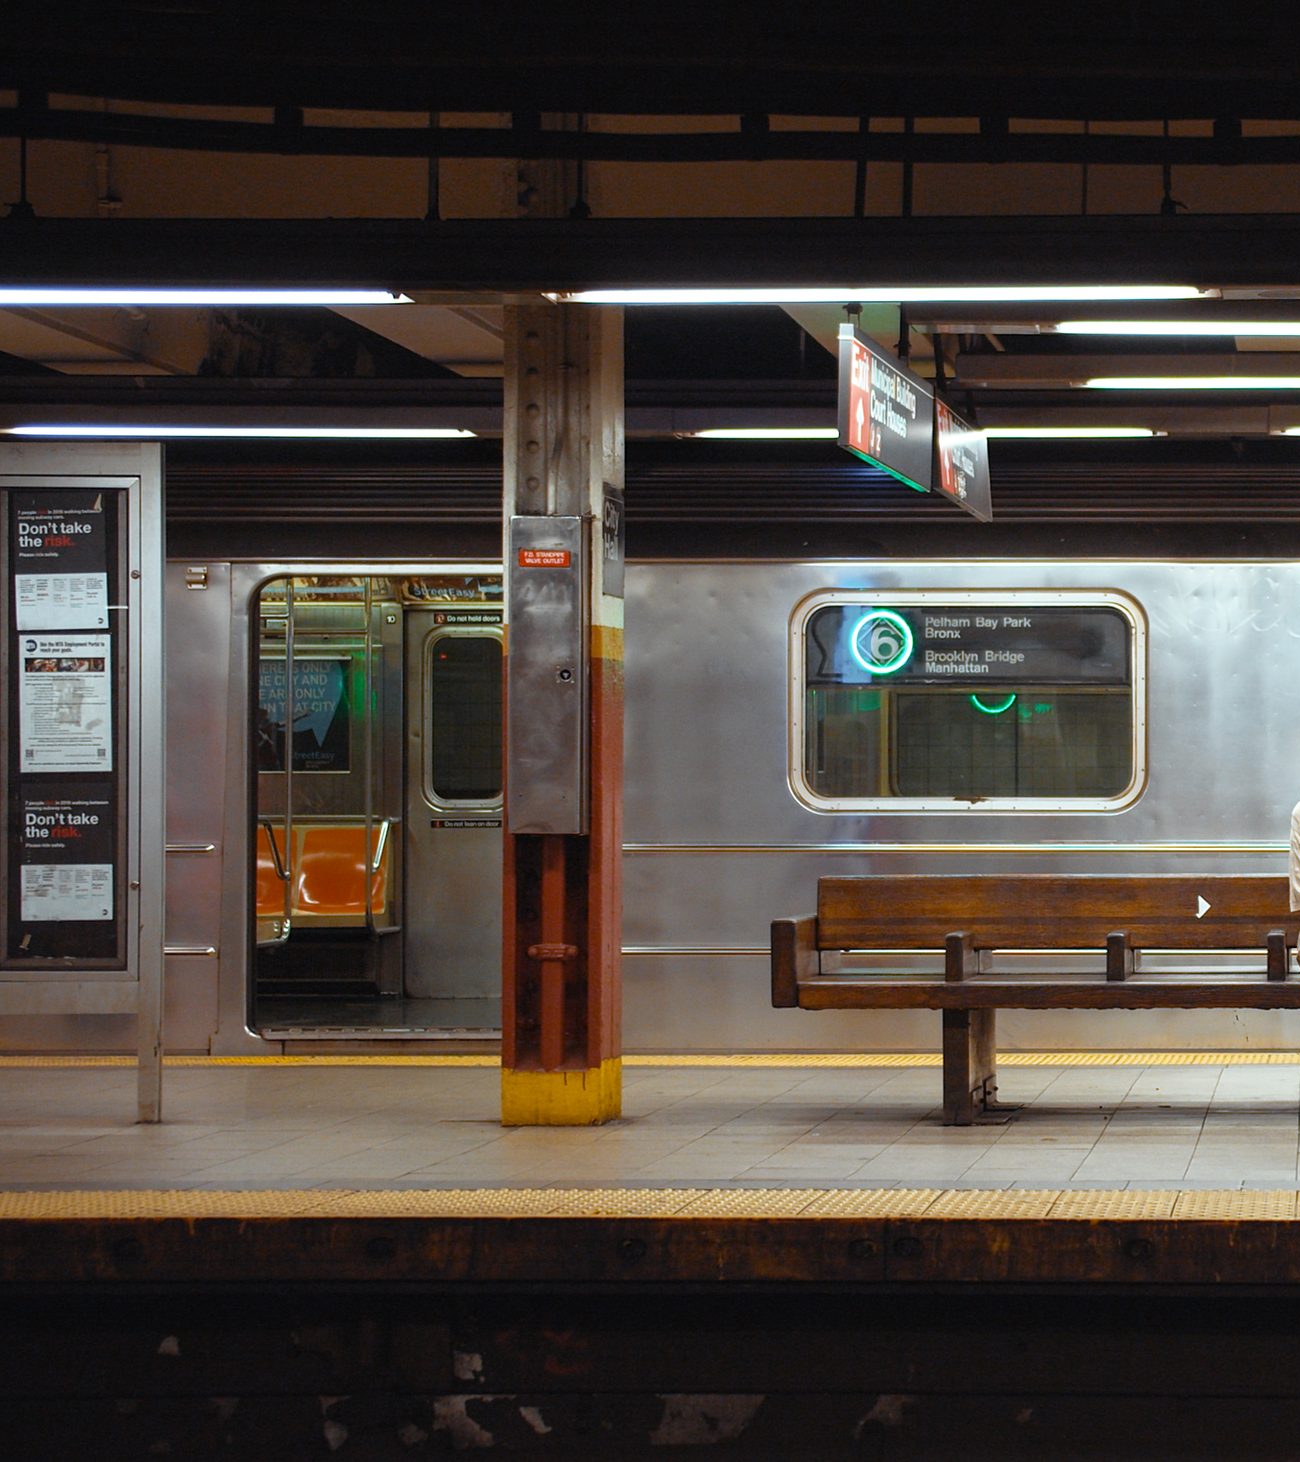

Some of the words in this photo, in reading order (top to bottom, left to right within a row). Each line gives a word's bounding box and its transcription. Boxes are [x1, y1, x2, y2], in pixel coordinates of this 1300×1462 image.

[851, 343, 870, 393] Exit
[871, 356, 897, 402] Municipal
[897, 375, 917, 420] Building
[870, 389, 887, 425] Court
[886, 400, 907, 438] Houses
[605, 501, 620, 536] City
[18, 522, 58, 535] Don't
[60, 521, 92, 535] take
[18, 535, 43, 548] the
[44, 535, 76, 547] risk.
[413, 585, 476, 599] StreetEasy
[386, 615, 396, 623] 10
[925, 616, 970, 628] Pelham
[976, 616, 998, 630] Bay
[1003, 616, 1032, 628] Park
[925, 627, 962, 639] Bronx
[870, 626, 900, 661] 6
[925, 650, 979, 665] Brooklyn
[985, 650, 1025, 664] Bridge
[303, 662, 332, 673] ONLY
[925, 661, 990, 673] Manhattan
[259, 674, 272, 686] NE
[274, 674, 300, 686] CIY
[302, 674, 328, 686] AND
[295, 688, 326, 700] ONLY
[263, 702, 277, 713] IN
[279, 702, 309, 713] TAT
[311, 702, 337, 713] CITY
[25, 813, 65, 825] Don't
[67, 812, 99, 825] take
[25, 826, 49, 838] the
[50, 825, 82, 838] risk.
